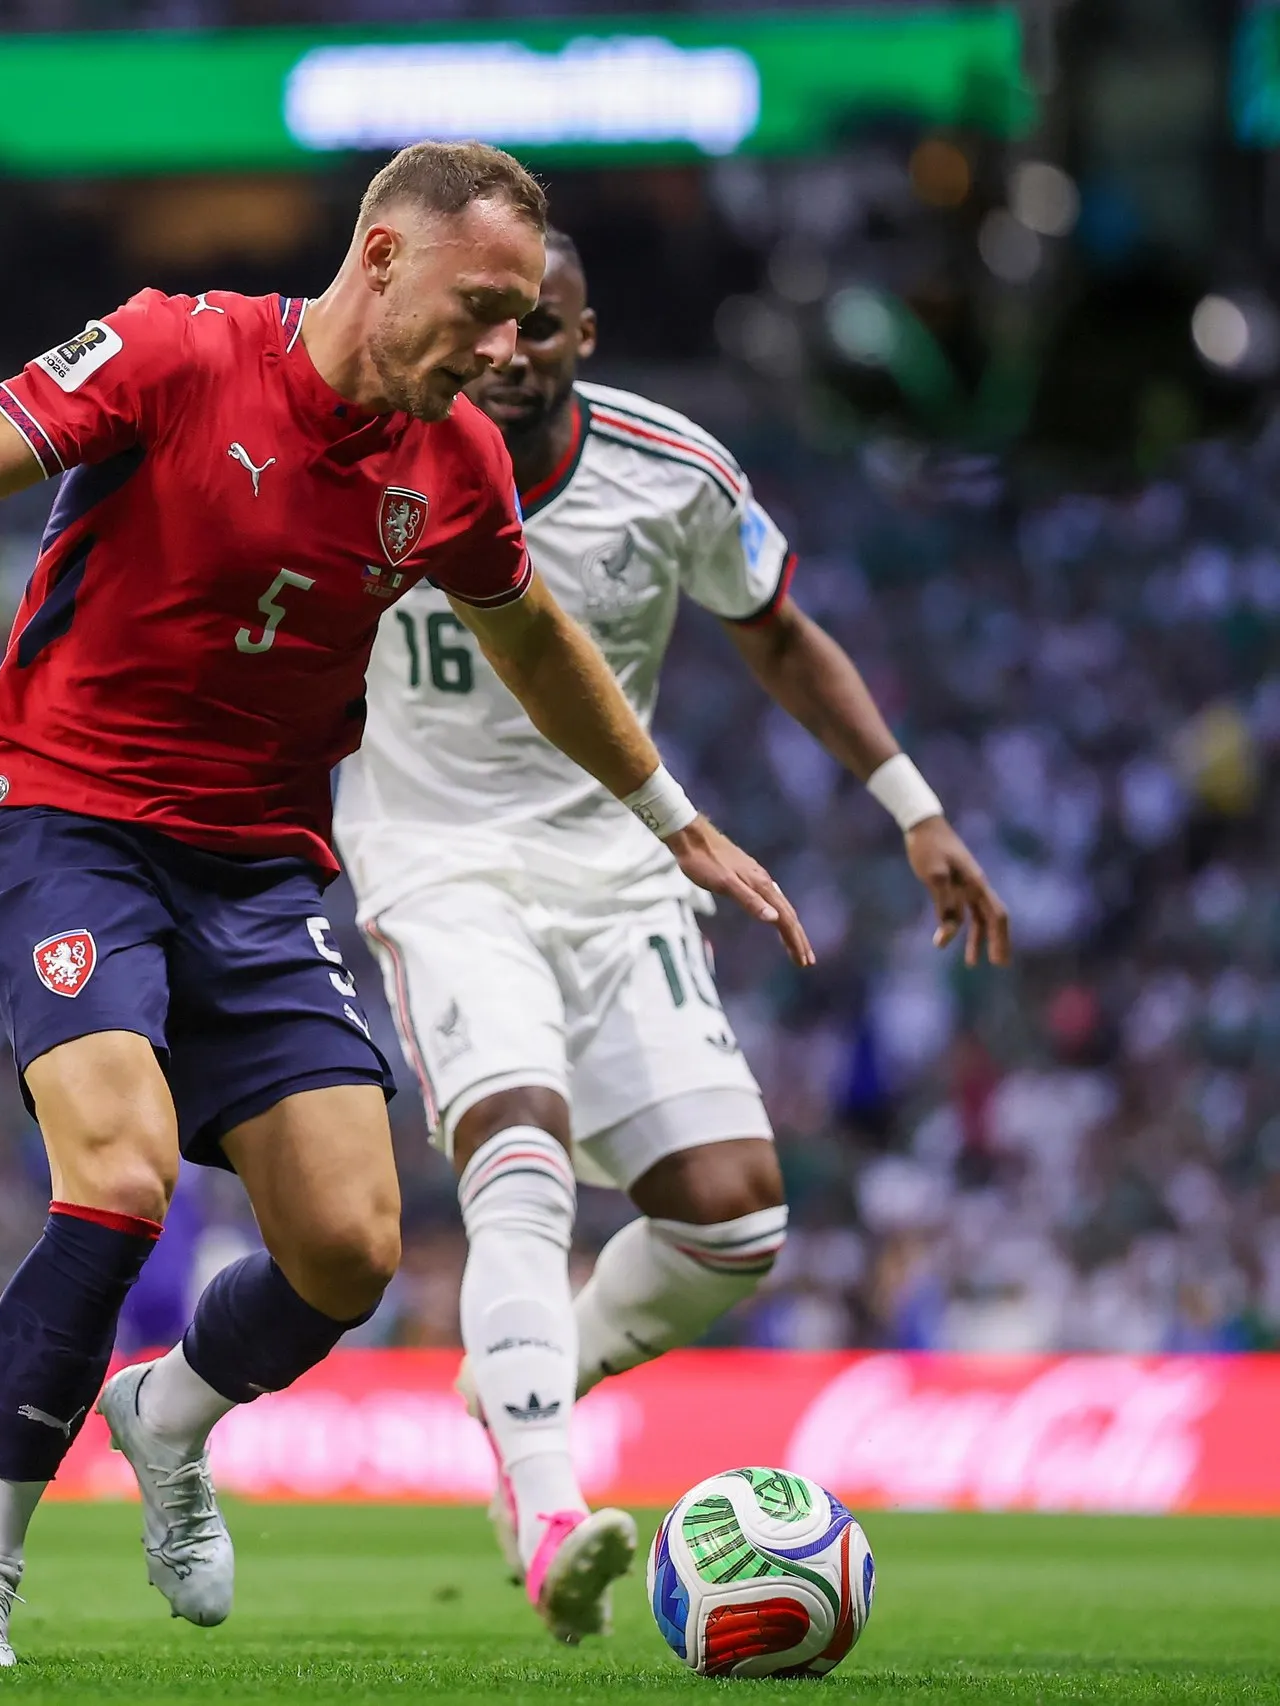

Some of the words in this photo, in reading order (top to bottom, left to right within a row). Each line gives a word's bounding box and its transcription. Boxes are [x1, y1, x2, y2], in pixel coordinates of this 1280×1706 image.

[42, 355, 67, 378] 2026
[235, 567, 316, 654] 5
[395, 609, 473, 695] 16
